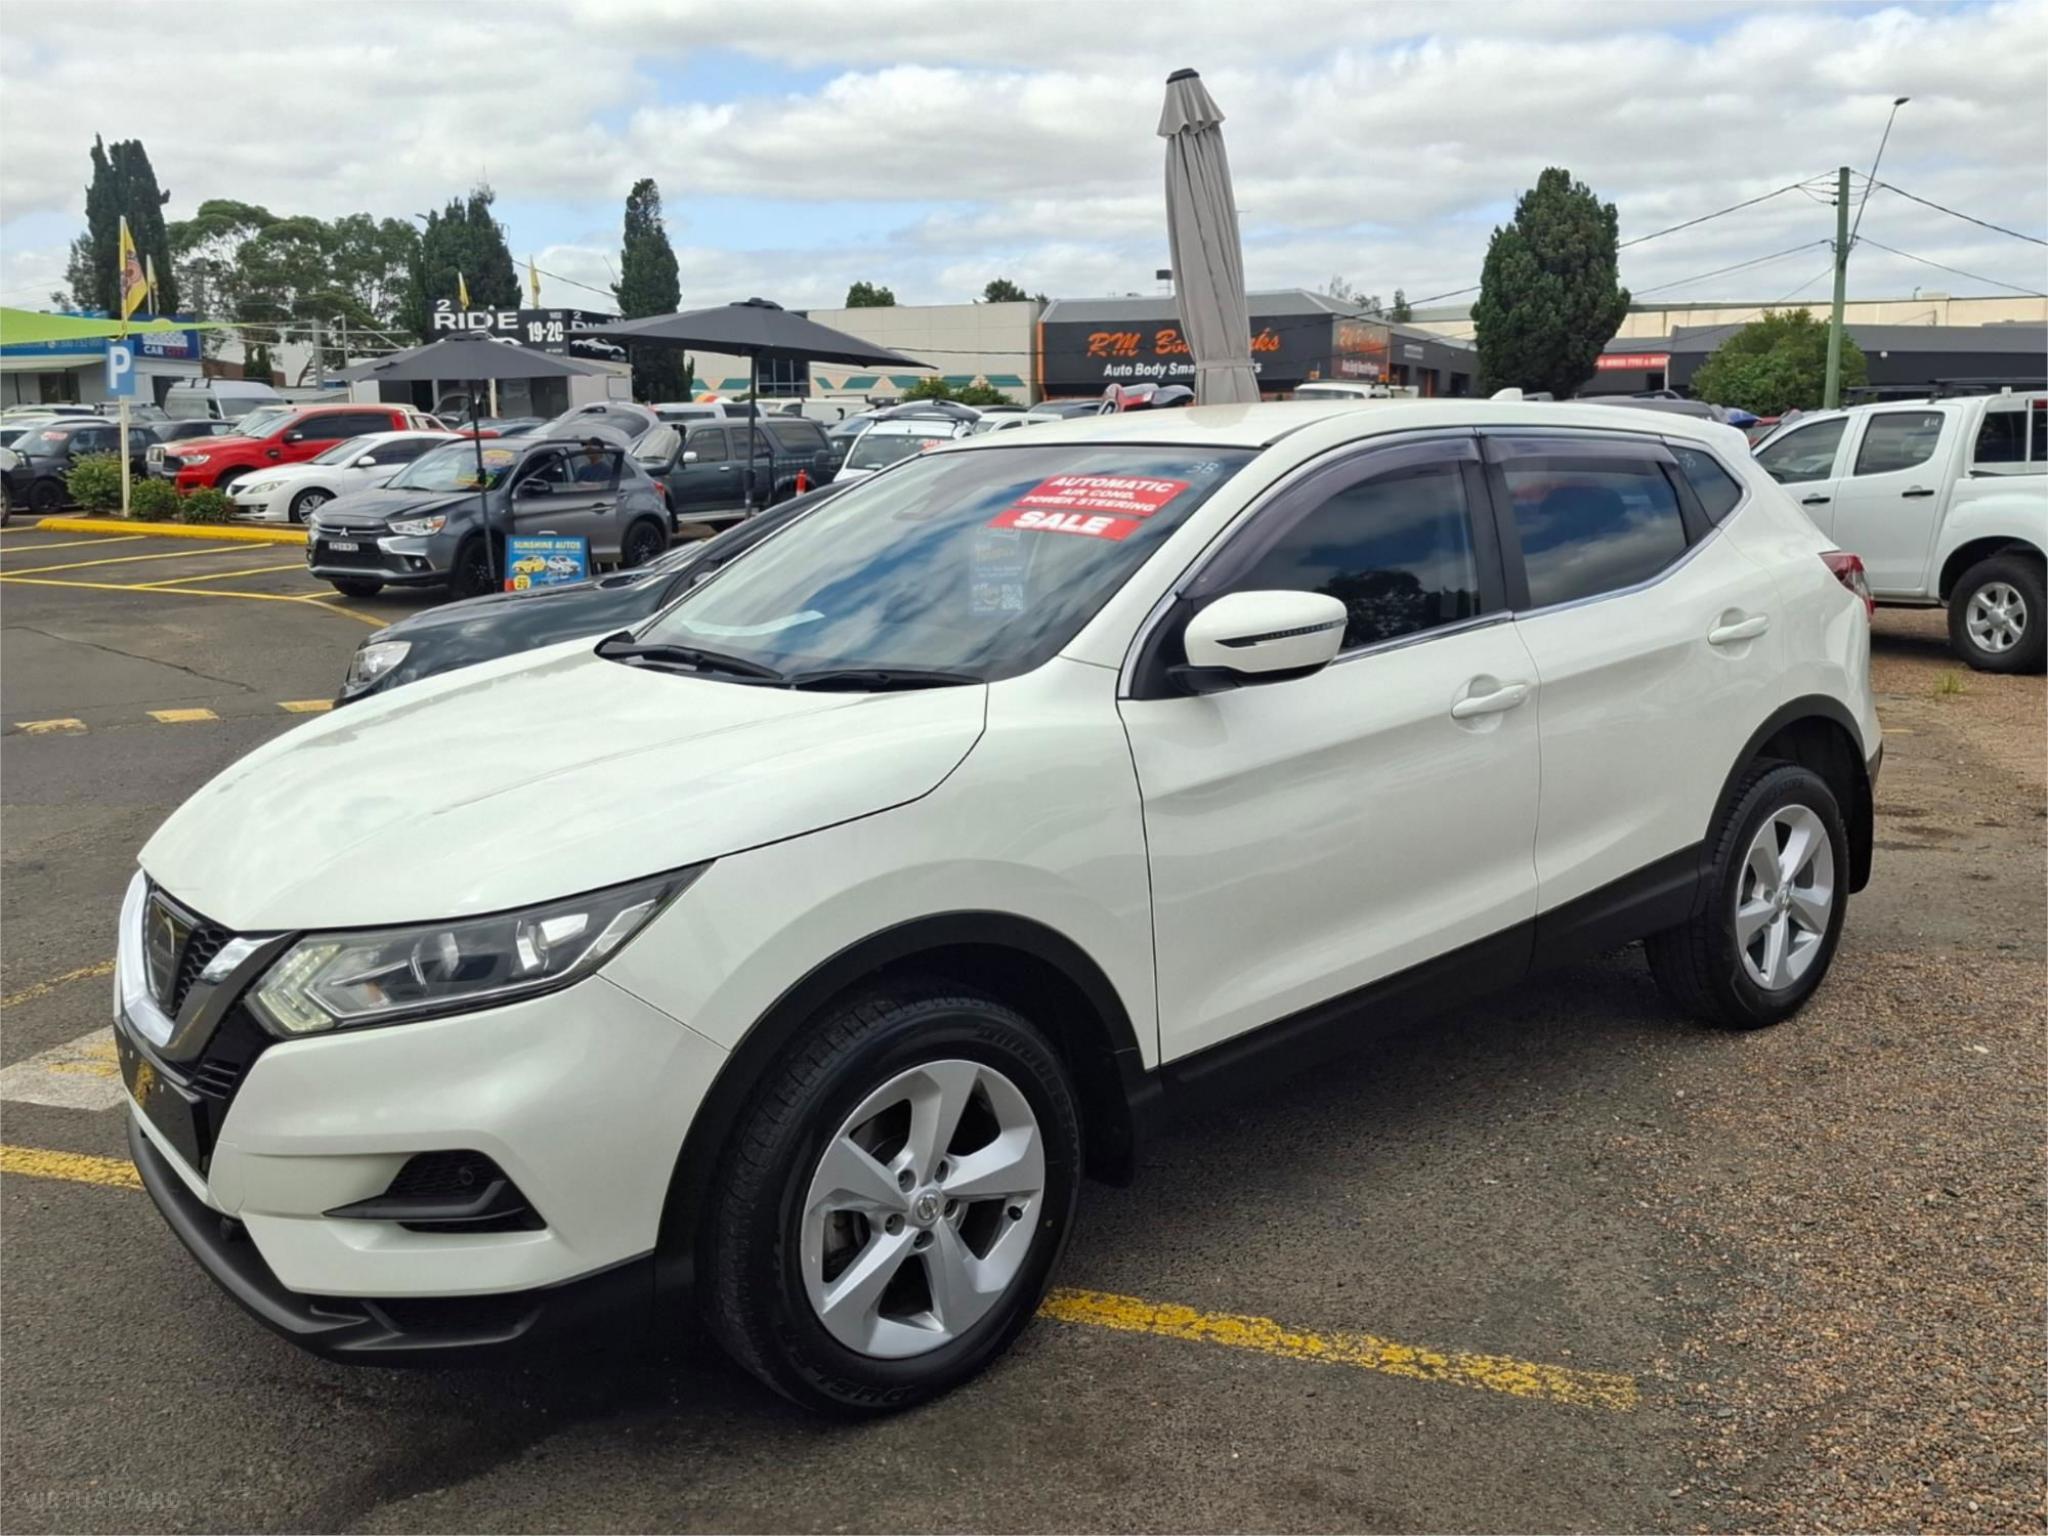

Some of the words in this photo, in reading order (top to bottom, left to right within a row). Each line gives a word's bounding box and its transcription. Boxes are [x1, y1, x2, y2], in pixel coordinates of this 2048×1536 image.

[436, 299, 451, 312] 2
[433, 311, 519, 330] RIDE
[144, 344, 164, 355] CAR
[1087, 331, 1142, 357] RM
[109, 346, 132, 390] P
[1104, 363, 1132, 376] Auto
[1134, 363, 1167, 379] Body
[1050, 477, 1175, 493] AUTOMATIC
[1058, 487, 1086, 496] AIR
[1021, 495, 1074, 505] POWER
[1075, 498, 1158, 512] STEERING
[1013, 510, 1116, 535] SALE
